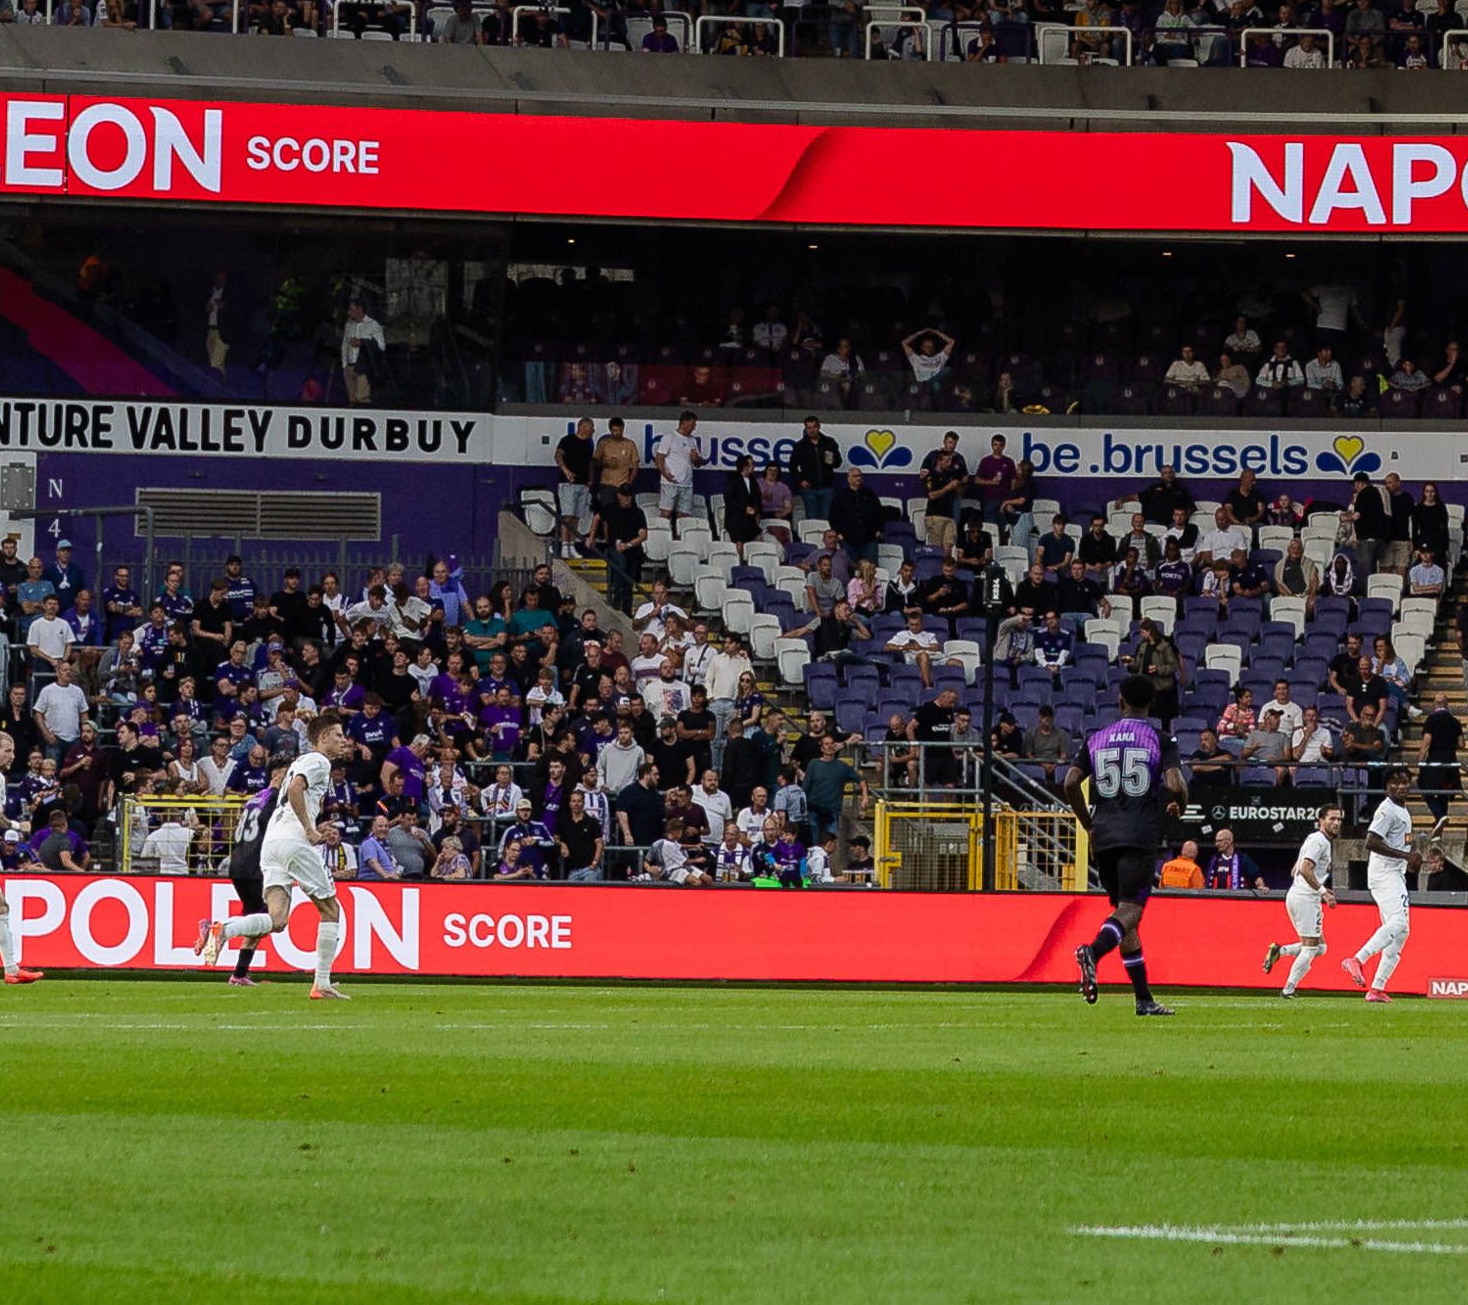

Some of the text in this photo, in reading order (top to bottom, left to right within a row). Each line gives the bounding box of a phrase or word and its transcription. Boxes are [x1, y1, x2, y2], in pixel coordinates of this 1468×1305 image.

[246, 135, 380, 175] SCORE
[127, 406, 273, 454] VALLEY
[287, 415, 476, 454] DURBUY
[48, 478, 63, 498] N
[48, 518, 61, 538] 4
[1095, 747, 1151, 798] 55
[443, 913, 573, 949] SCORE
